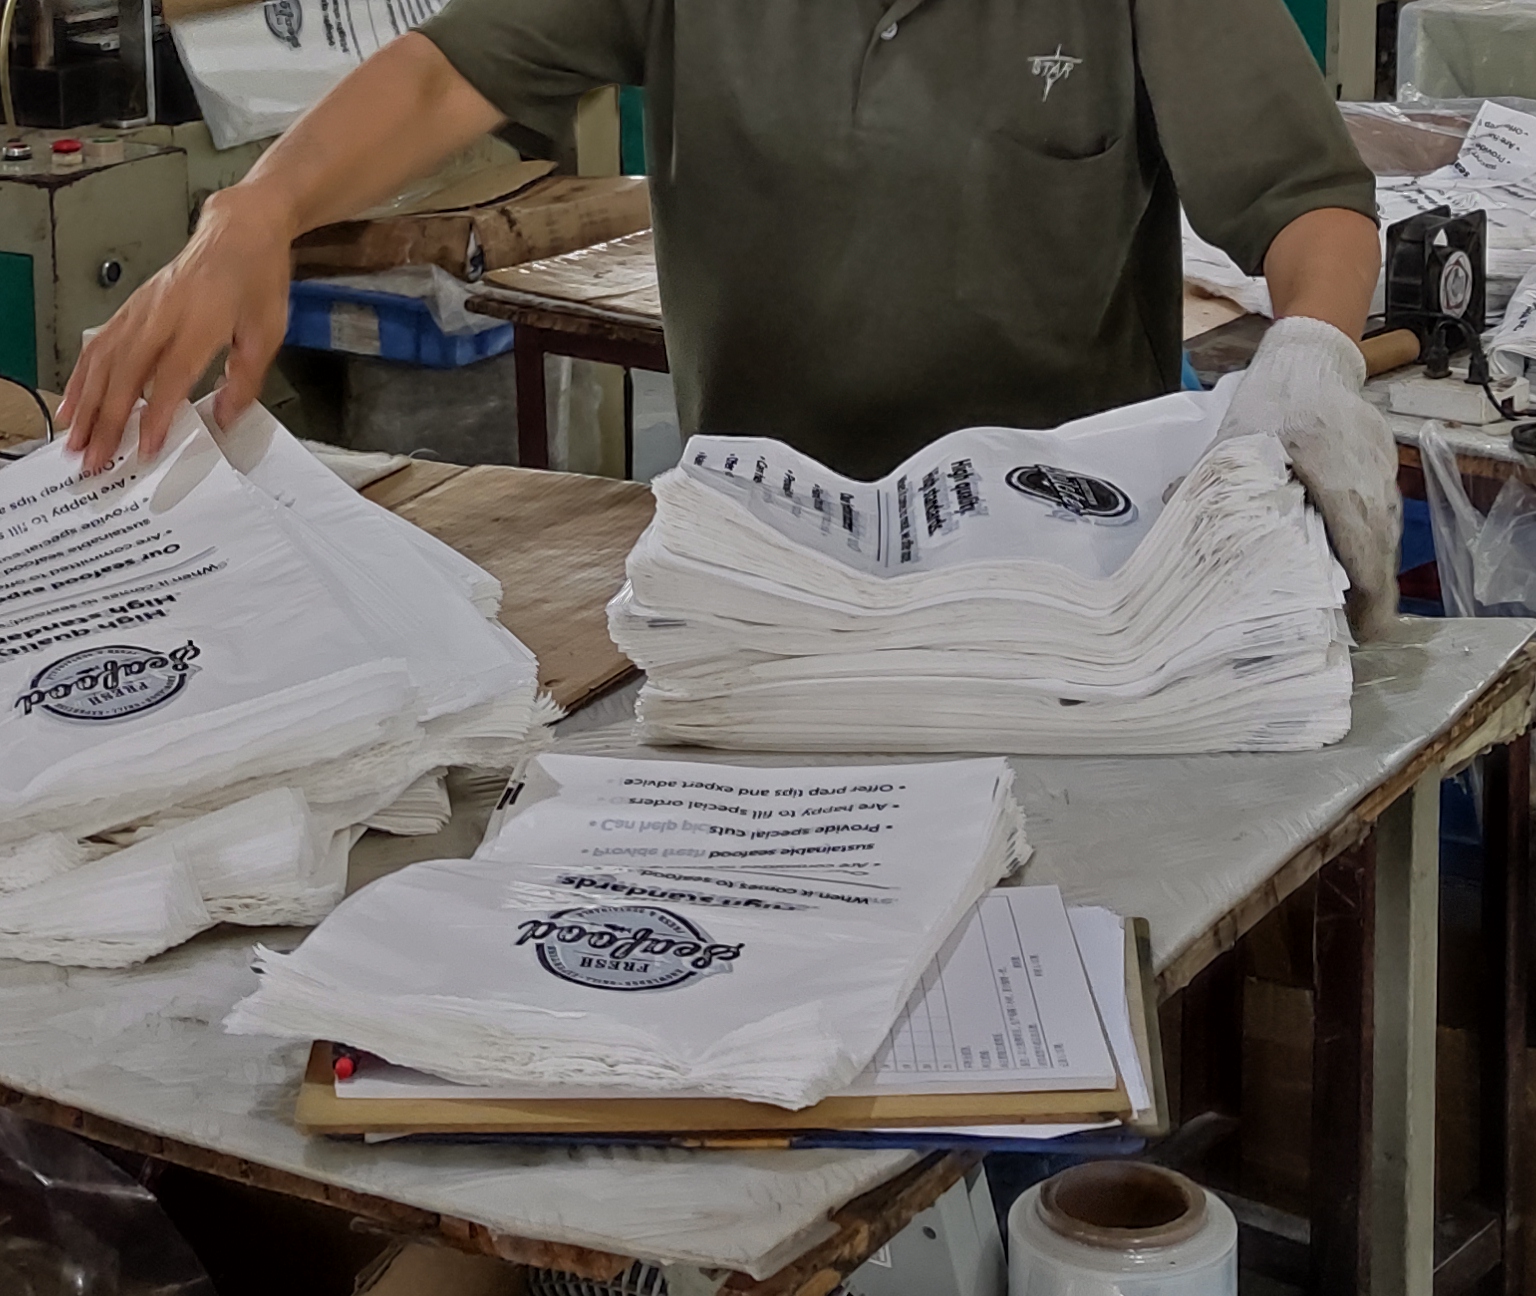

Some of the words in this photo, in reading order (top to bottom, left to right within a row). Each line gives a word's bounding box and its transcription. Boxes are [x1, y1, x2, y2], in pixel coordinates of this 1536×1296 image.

[947, 458, 974, 482] High
[39, 475, 74, 501] prep
[100, 476, 126, 498] Are
[918, 467, 939, 492] High
[9, 493, 37, 516] tips
[51, 489, 98, 518] happy
[950, 482, 980, 516] quality.
[30, 513, 48, 527] to
[80, 500, 140, 533] Provide
[923, 487, 946, 537] standards.
[68, 518, 150, 556] sustainable
[136, 532, 162, 549] Are
[49, 540, 133, 575] committed
[141, 543, 180, 562] Our
[3, 550, 63, 576] seafood
[50, 560, 135, 590] seafood
[171, 563, 219, 583] When
[108, 593, 177, 616] High
[97, 608, 167, 633] High
[14, 639, 201, 716] Seafood
[87, 682, 149, 706] FRESH
[624, 777, 678, 789] advice
[681, 778, 734, 794] expert
[808, 784, 847, 798] prep
[849, 783, 894, 794] Offer
[738, 787, 769, 799] and
[774, 786, 804, 800] tips
[628, 796, 684, 808] orders
[687, 800, 748, 817] special
[801, 802, 854, 818] happy
[858, 802, 888, 813] Are
[751, 808, 774, 820] fill
[778, 808, 796, 819] to
[708, 825, 747, 838] cuts
[751, 825, 810, 841] special
[814, 823, 880, 835] Provide
[708, 847, 776, 860] seafood
[780, 842, 875, 858] sustainable
[714, 879, 734, 888] to
[738, 882, 798, 894] comes
[800, 888, 814, 901] it
[818, 890, 869, 906] When
[513, 919, 745, 971] Seafood
[579, 956, 650, 973] FRESH
